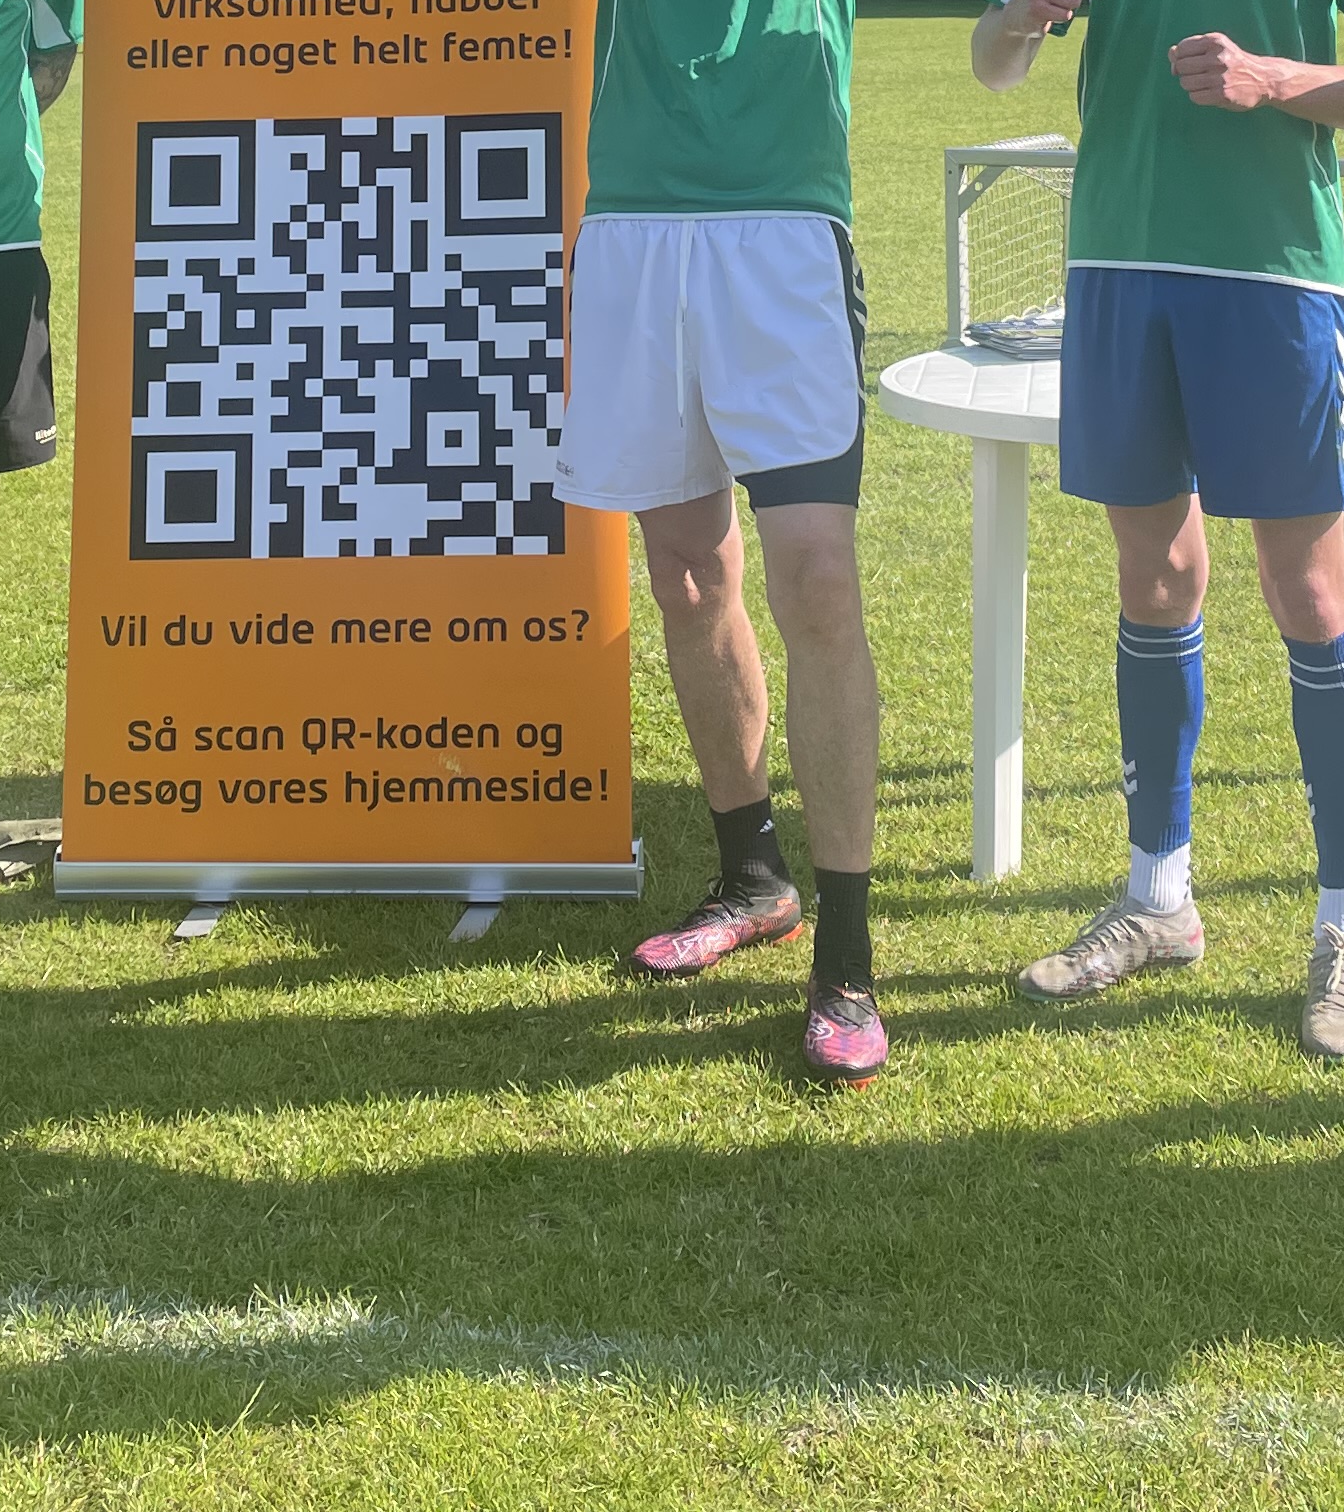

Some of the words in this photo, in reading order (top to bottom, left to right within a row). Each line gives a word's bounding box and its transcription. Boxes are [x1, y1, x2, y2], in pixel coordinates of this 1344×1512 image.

[127, 38, 210, 70] eller
[224, 38, 337, 74] noget
[353, 33, 428, 65] helt
[443, 28, 571, 63] femte!
[100, 615, 147, 647] Vil
[163, 614, 213, 647] du
[229, 612, 314, 645] vide
[331, 618, 432, 644] mere
[447, 617, 507, 643] om
[523, 609, 590, 642] os?
[127, 715, 177, 752] Så
[194, 725, 284, 752] scan
[302, 716, 500, 756] QR-koden
[516, 723, 563, 757] og
[84, 773, 202, 814] besøg
[218, 778, 328, 805] vores
[345, 768, 608, 812] hjemmeside!
